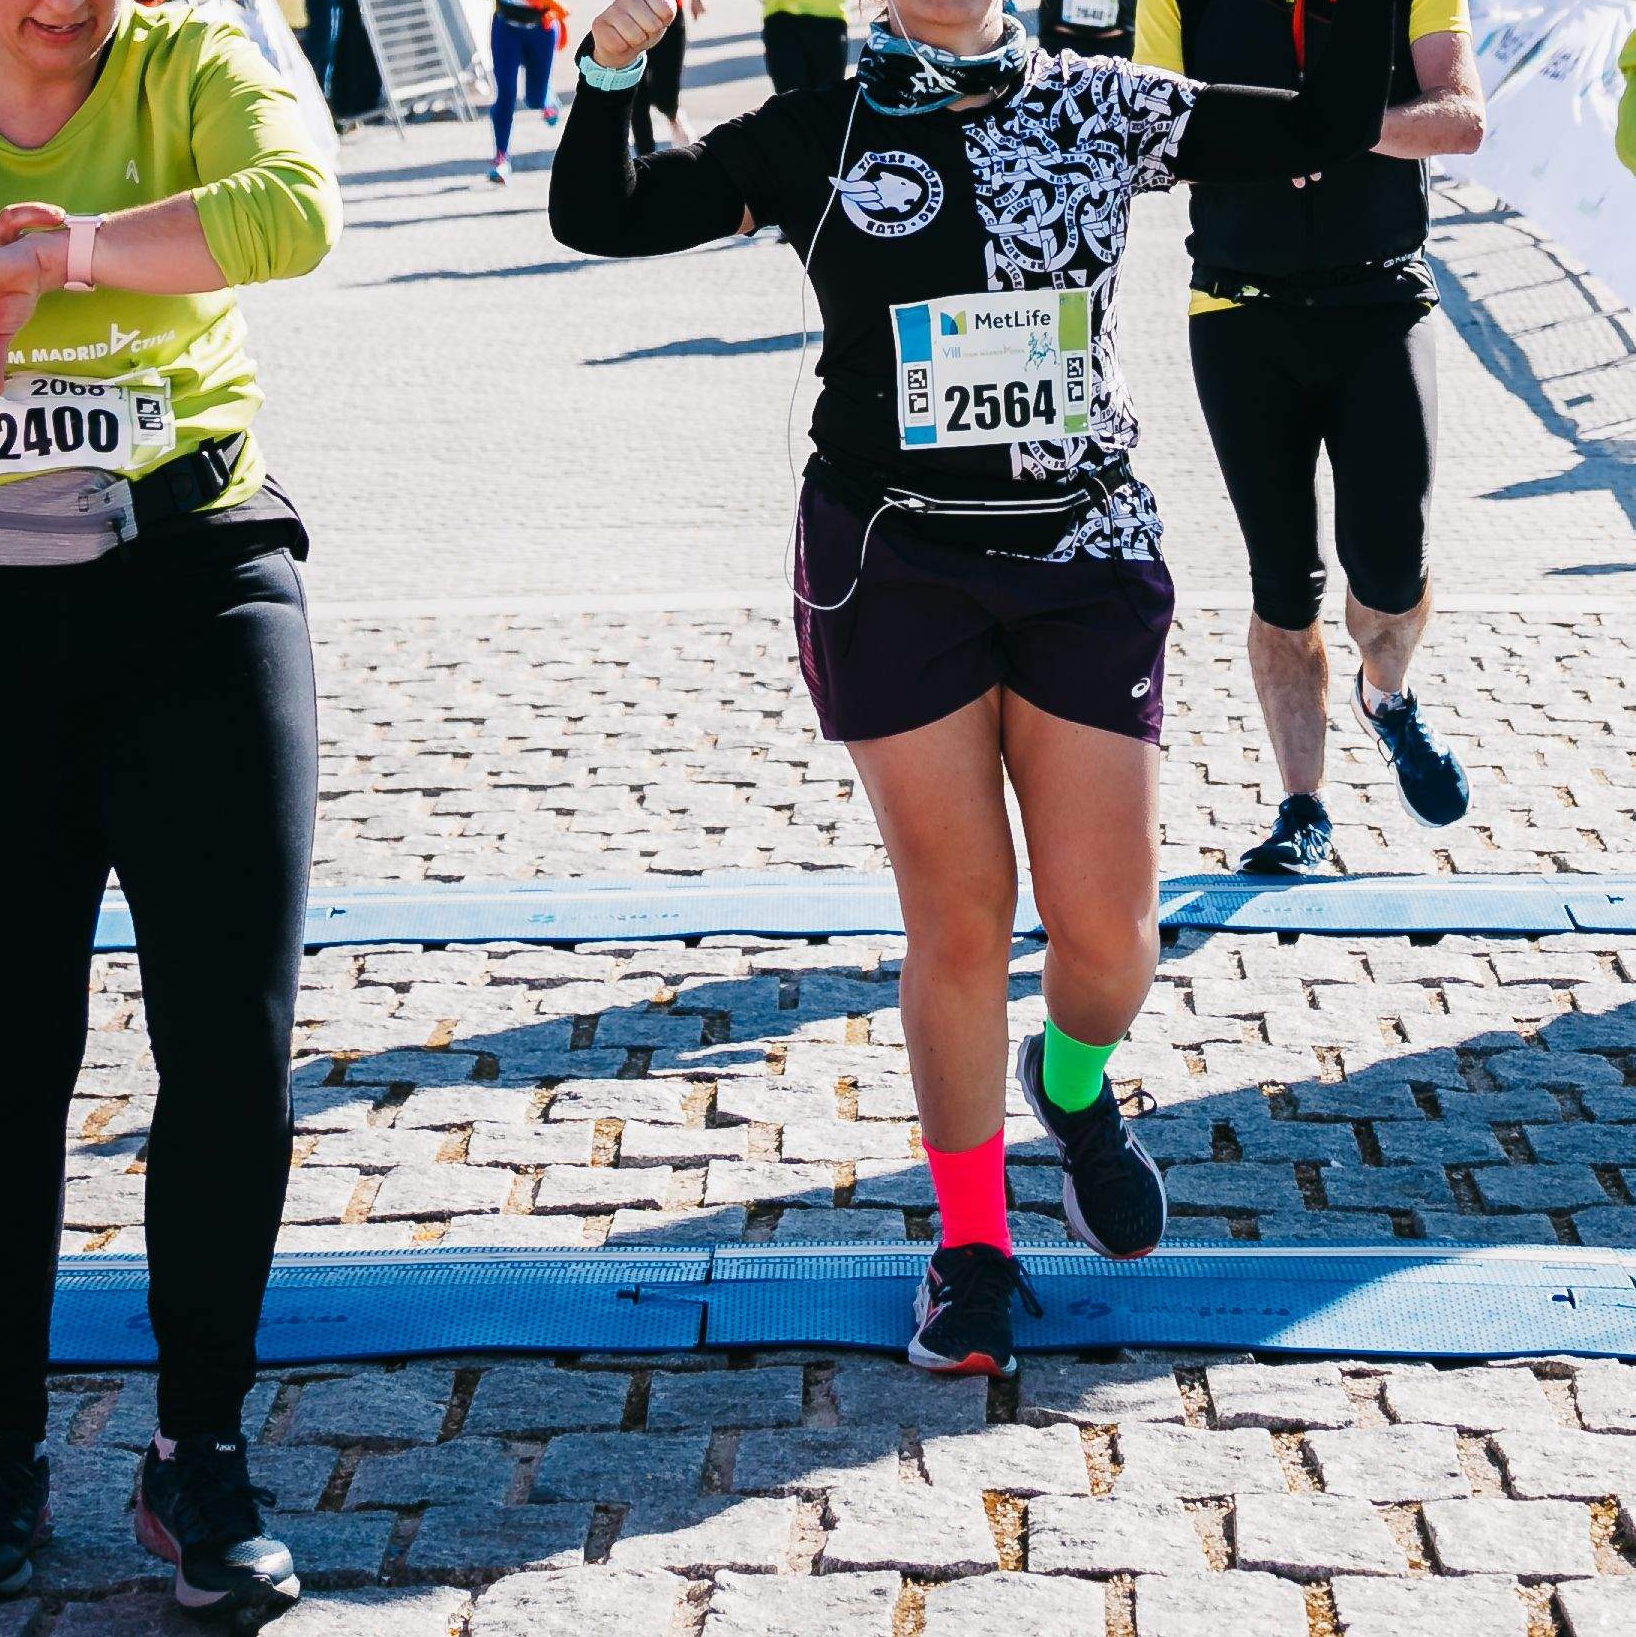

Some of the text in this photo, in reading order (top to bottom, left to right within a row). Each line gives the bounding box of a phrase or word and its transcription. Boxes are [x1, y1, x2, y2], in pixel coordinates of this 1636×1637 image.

[974, 309, 1052, 331] MetLife
[31, 342, 108, 363] MADRID
[944, 379, 1057, 433] 2564
